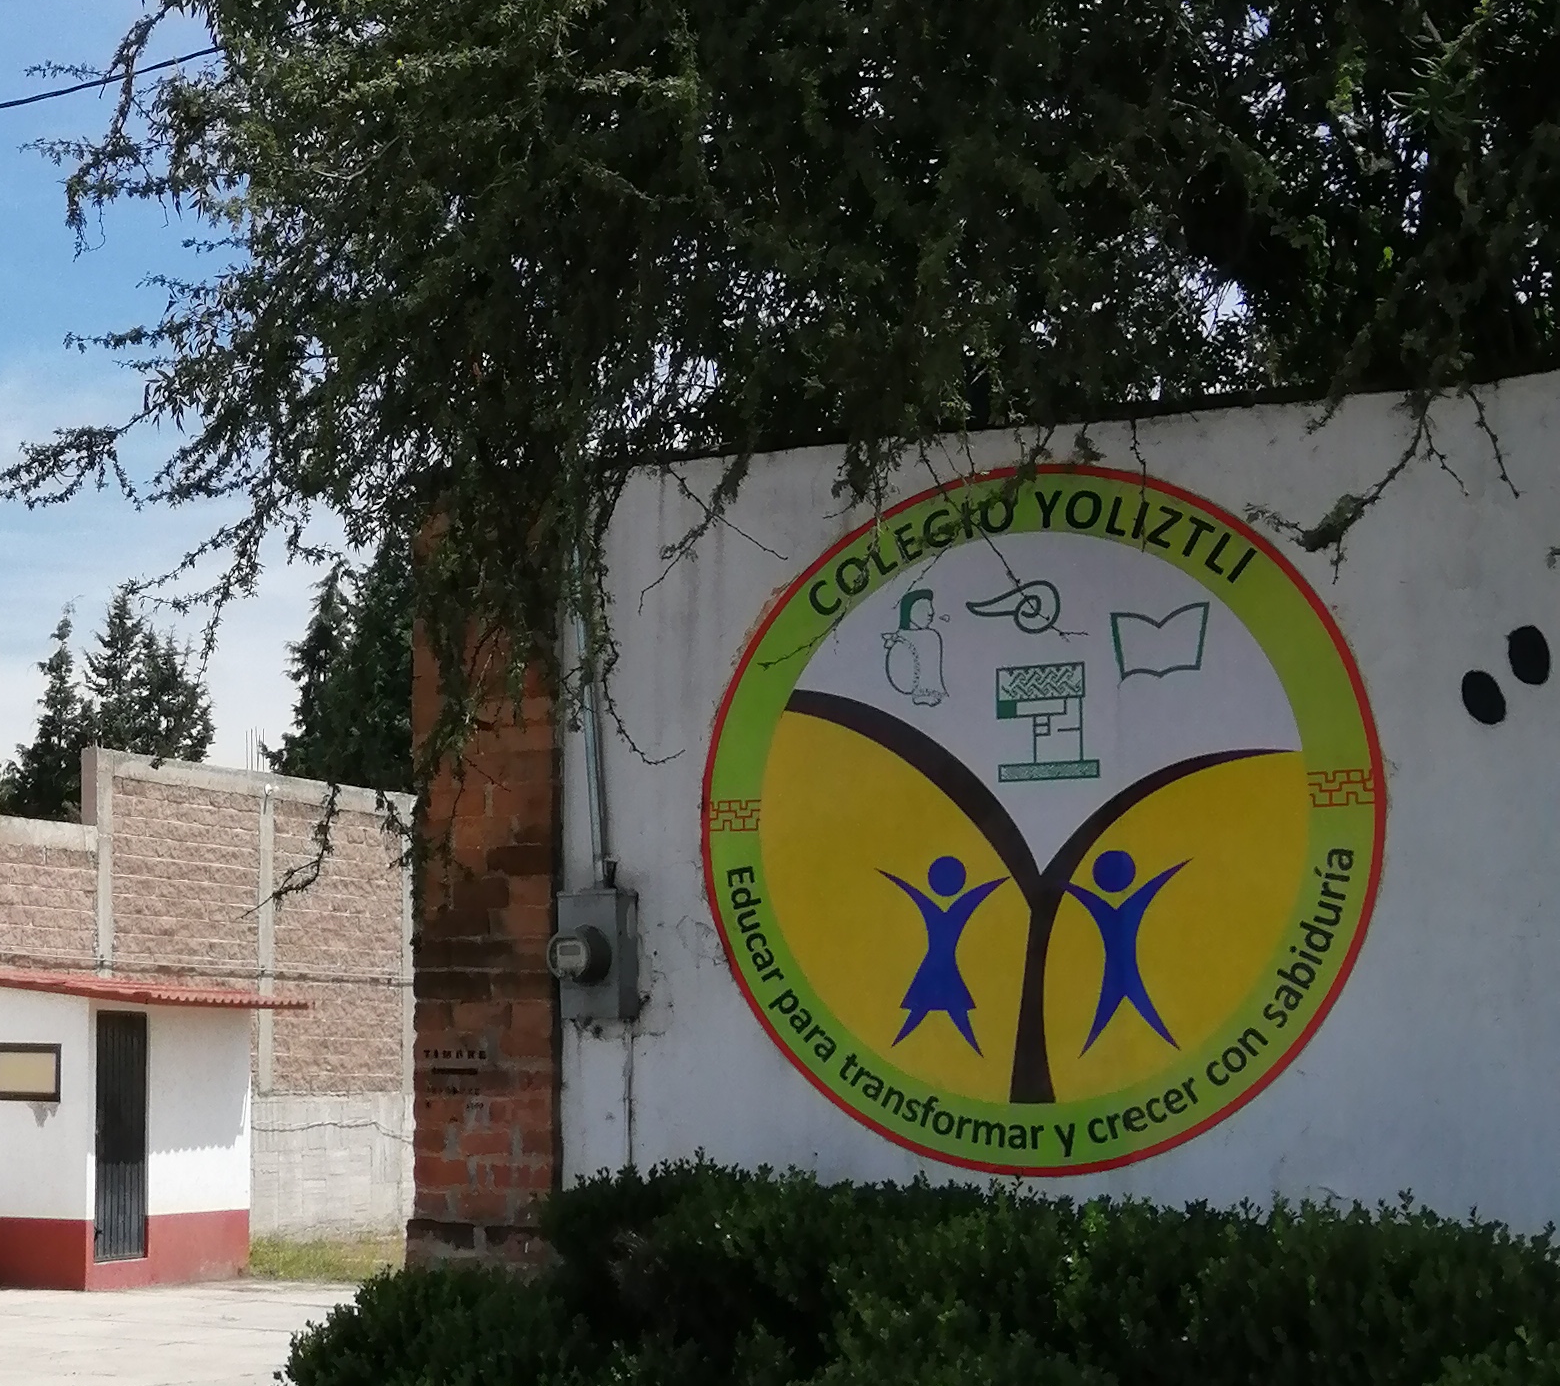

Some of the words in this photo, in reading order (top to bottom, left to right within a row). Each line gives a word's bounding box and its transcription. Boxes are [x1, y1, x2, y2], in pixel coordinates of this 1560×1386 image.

[808, 496, 1017, 617] COLEGIO
[1034, 489, 1258, 584] YOLIZTLI
[726, 865, 785, 983] Educar
[768, 988, 838, 1063] para
[839, 1052, 1044, 1150] transformar
[1053, 1121, 1076, 1158] y
[1087, 1076, 1200, 1145] crecer
[1205, 1026, 1269, 1087] con
[1262, 847, 1355, 1029] sabiduría
